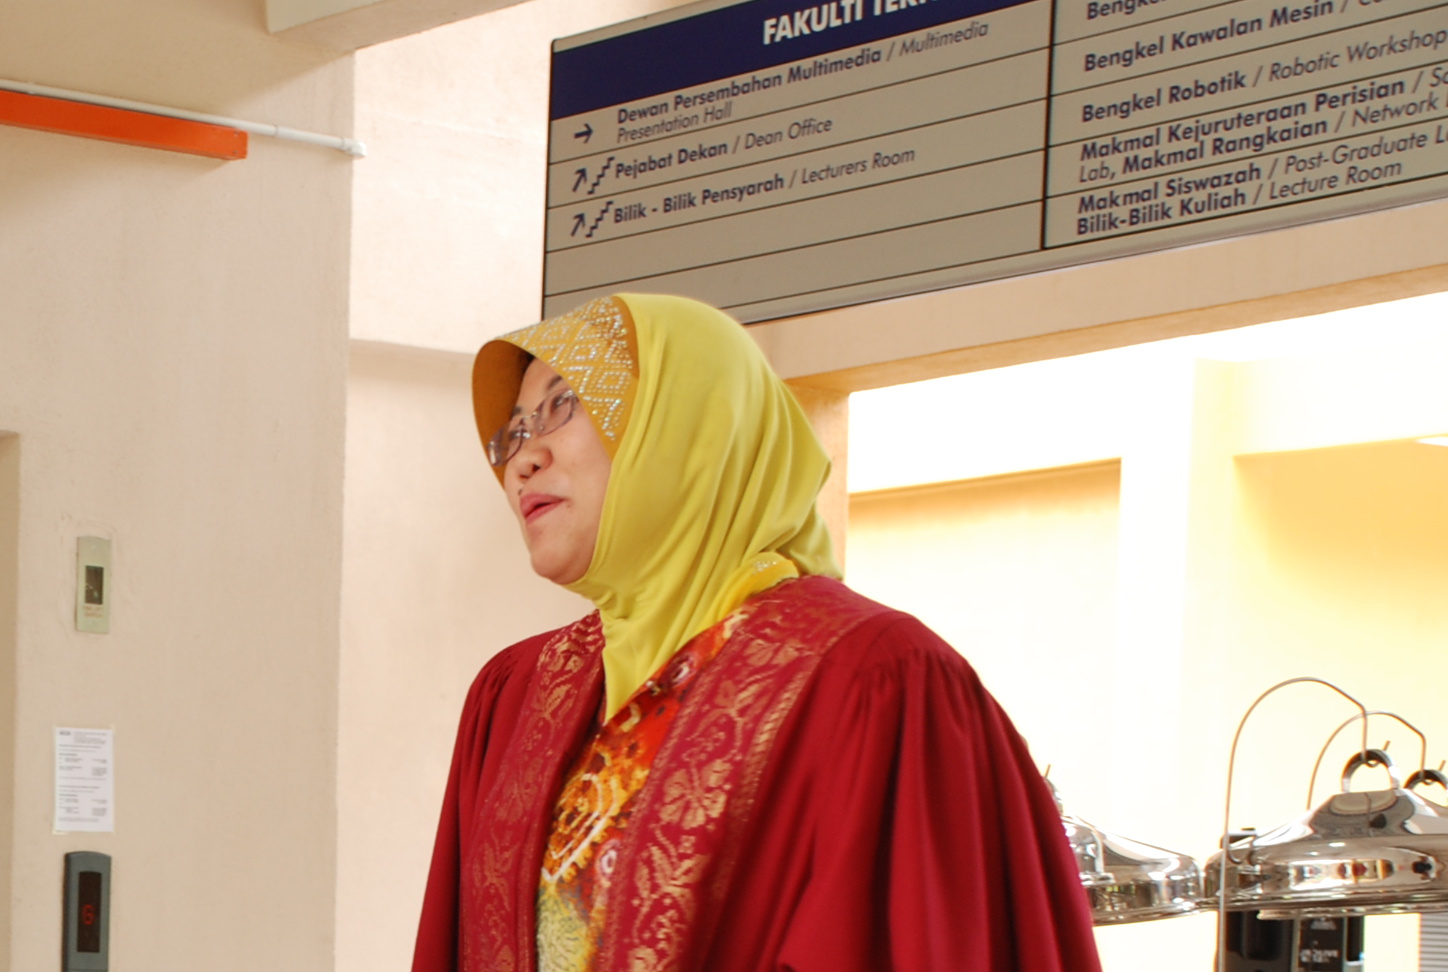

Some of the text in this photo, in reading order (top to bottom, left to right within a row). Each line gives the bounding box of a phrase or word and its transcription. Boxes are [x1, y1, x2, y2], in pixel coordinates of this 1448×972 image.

[763, 0, 863, 45] FAKULTI
[1084, 35, 1164, 71] Bengkel
[1171, 17, 1262, 51] Kawalan
[1269, 0, 1333, 28] Mesin
[618, 22, 989, 124] Dewan Persembahan Multimedia / Multimedia
[1082, 30, 1447, 122] Bengkel Robotik / Robotic Workshop
[615, 118, 833, 179] Pejabat Dekan / Dean Office
[617, 101, 733, 143] Presentation Hall
[1080, 128, 1160, 161] Makmal
[1168, 102, 1306, 142] Kejuruteraan
[1314, 80, 1405, 112] Perisian
[1412, 70, 1424, 94] /
[1080, 162, 1116, 182] Lab,
[1122, 141, 1205, 174] Makmal
[1212, 119, 1327, 156] Rangkaian
[1334, 111, 1345, 132] /
[1352, 91, 1439, 127] Network
[614, 201, 647, 223] Bilik
[663, 192, 697, 214] Bilik
[702, 173, 784, 205] Pensyarah
[788, 170, 797, 189] /
[801, 156, 867, 185] Lecturers
[872, 149, 915, 170] Room
[1077, 182, 1158, 214] Makmal
[1165, 163, 1261, 197] Siswazah
[1267, 158, 1278, 179] /
[1284, 132, 1428, 174] Post-Graduate
[1077, 162, 1402, 235] Bilik-Bilik Kuliah / Lecture Room
